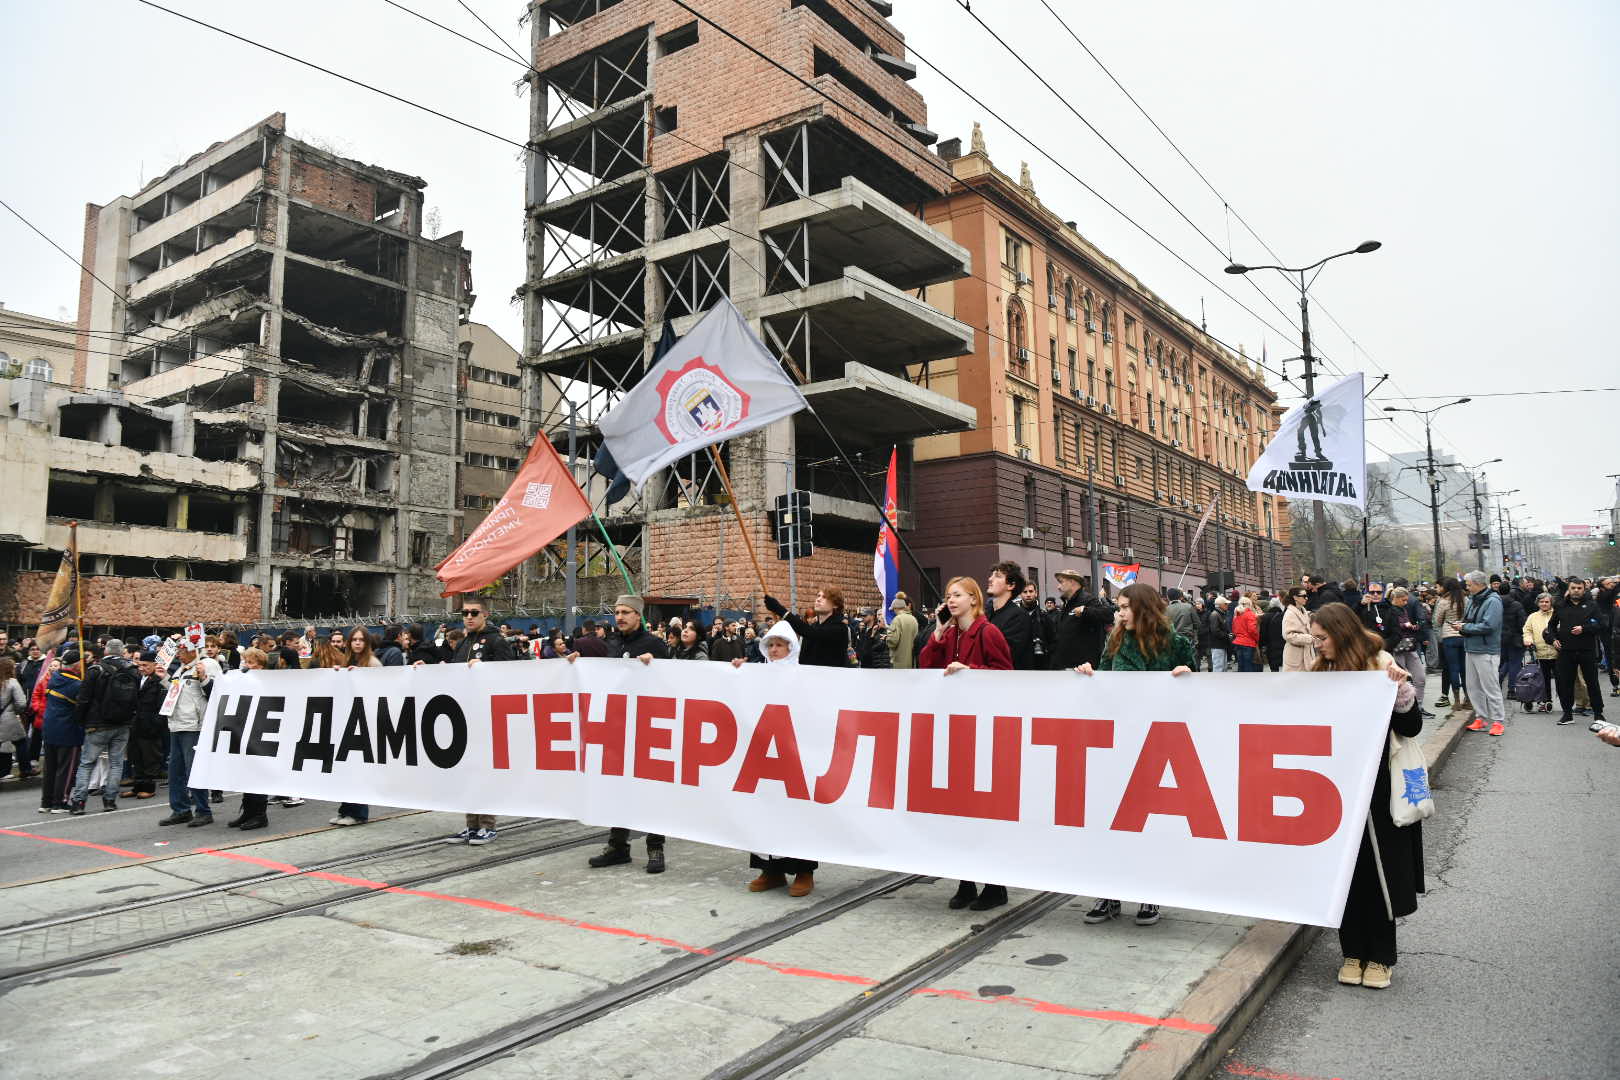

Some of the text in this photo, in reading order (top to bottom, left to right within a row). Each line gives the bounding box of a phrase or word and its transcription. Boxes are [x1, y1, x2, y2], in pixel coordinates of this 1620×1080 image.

[211, 695, 286, 758] НЕ
[291, 694, 468, 774] ДАМО
[491, 692, 1343, 846] ГЕНЕРАЛШТАБ
